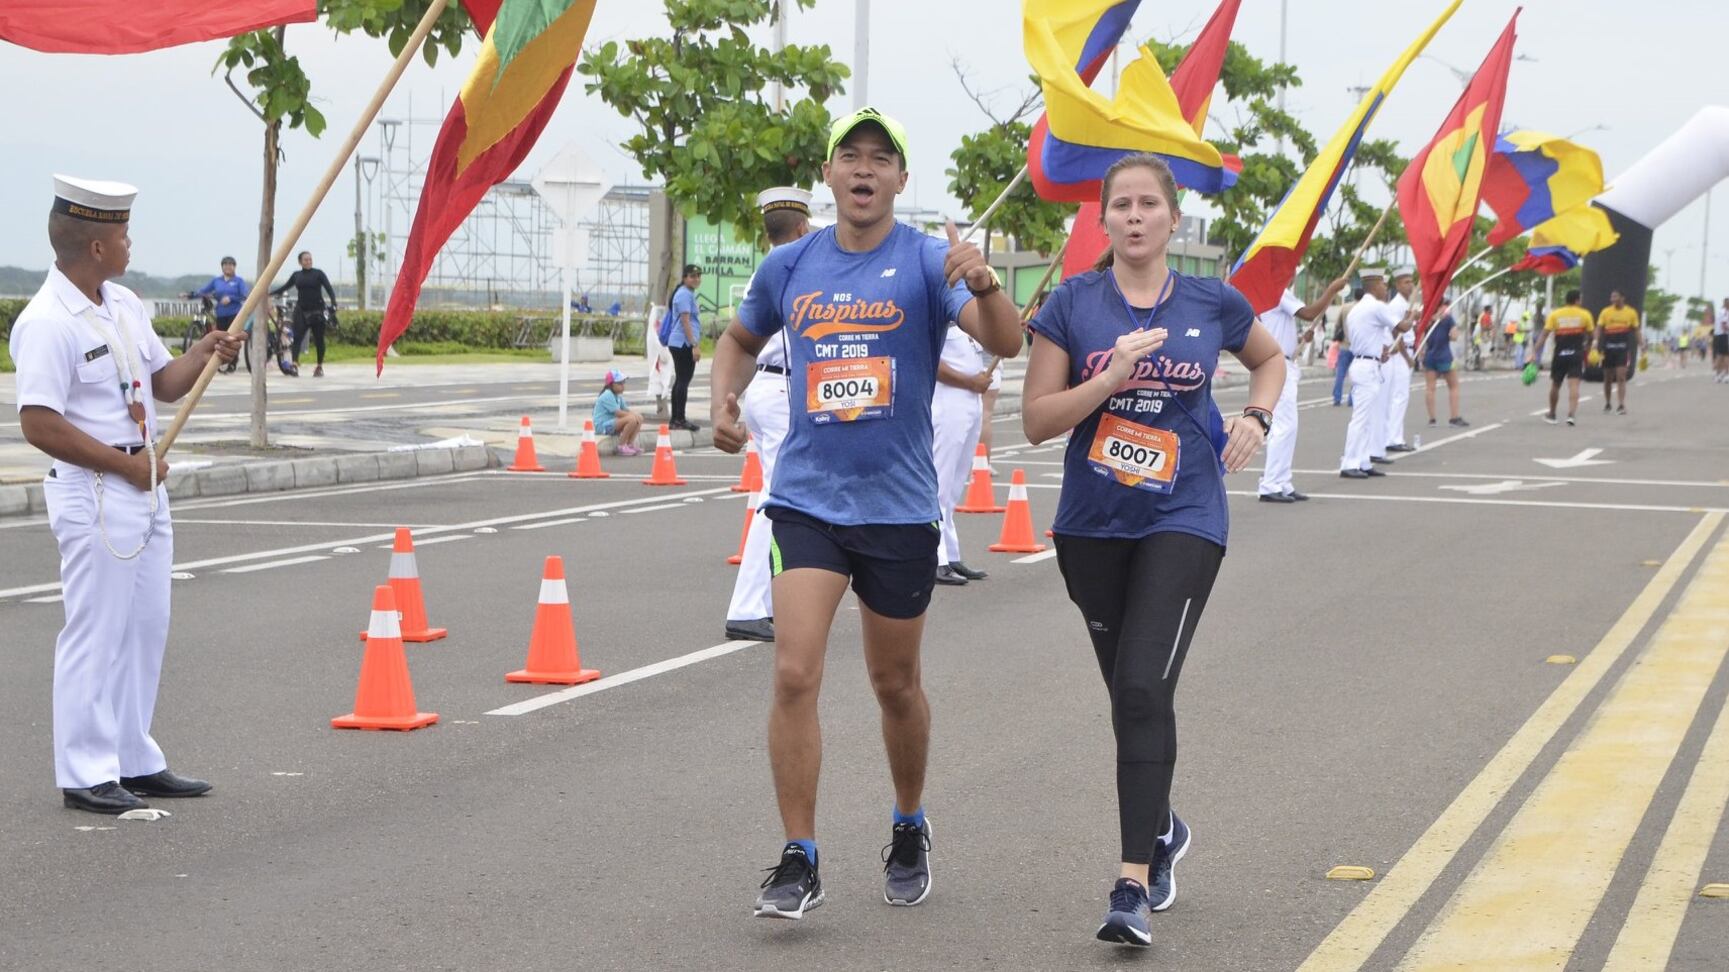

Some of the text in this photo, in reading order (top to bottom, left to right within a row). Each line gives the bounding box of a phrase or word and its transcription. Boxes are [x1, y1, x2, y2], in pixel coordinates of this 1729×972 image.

[694, 233, 725, 244] LLEGA
[705, 256, 750, 265] BARRAN
[832, 293, 852, 303] NOS
[790, 290, 899, 331] Inspiras
[838, 334, 855, 342] CORRE
[861, 333, 879, 341] TIERRA
[815, 344, 868, 358] CMT 2019
[823, 379, 873, 400] 8004
[1137, 390, 1153, 398] CORRE
[1109, 397, 1163, 414] CMT 2019
[1116, 425, 1135, 436] CORRE
[1142, 433, 1162, 443] TIERRA
[1109, 441, 1160, 468] 8007
[1120, 463, 1141, 475] YOSHI
